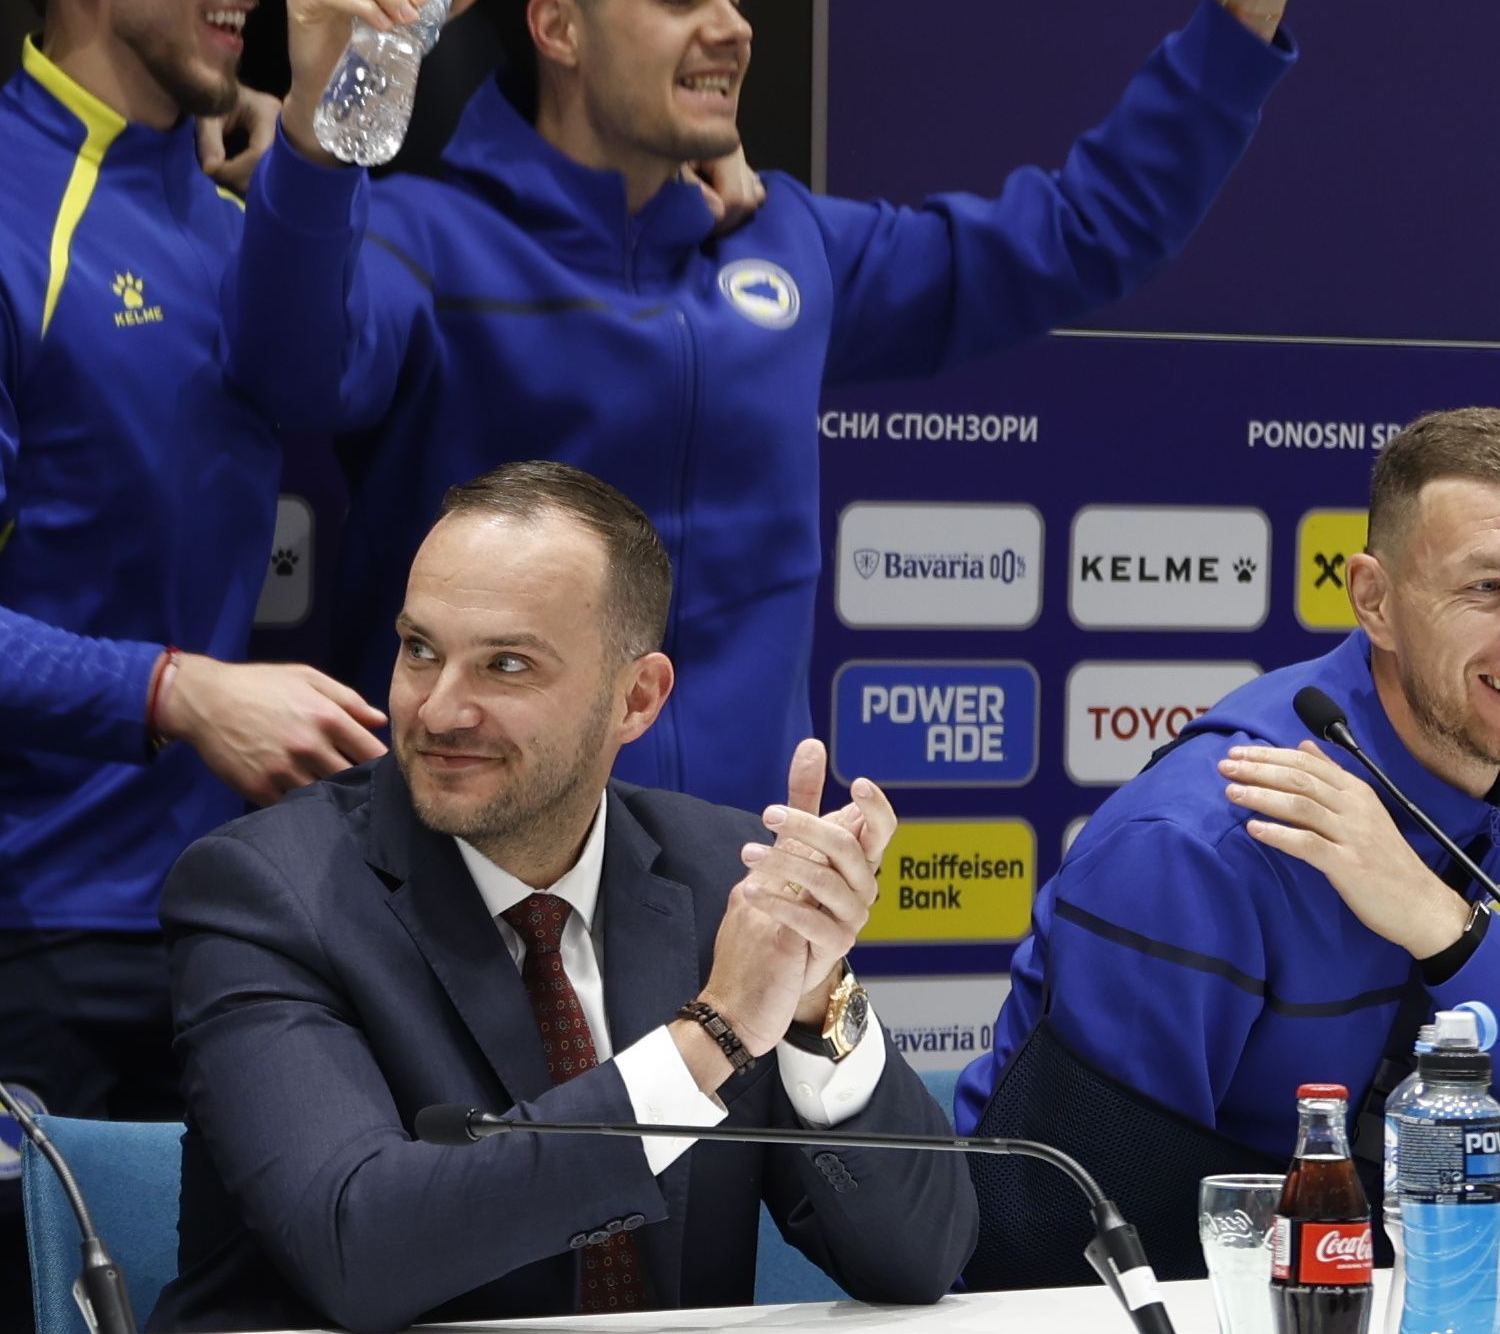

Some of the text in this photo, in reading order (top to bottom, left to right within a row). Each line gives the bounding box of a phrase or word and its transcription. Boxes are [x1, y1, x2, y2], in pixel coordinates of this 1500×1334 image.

[114, 306, 164, 327] KELME
[817, 411, 1039, 443] СНИ СПОНЗОРИ
[1248, 421, 1365, 450] PONOSNI
[884, 551, 985, 580] Bavaria
[1080, 555, 1219, 583] KELME
[862, 685, 1005, 724] POWER
[926, 725, 1005, 763] ADE
[899, 853, 1025, 881] Raiffeisen
[899, 885, 962, 911] Bank
[890, 1024, 975, 1052] avaria
